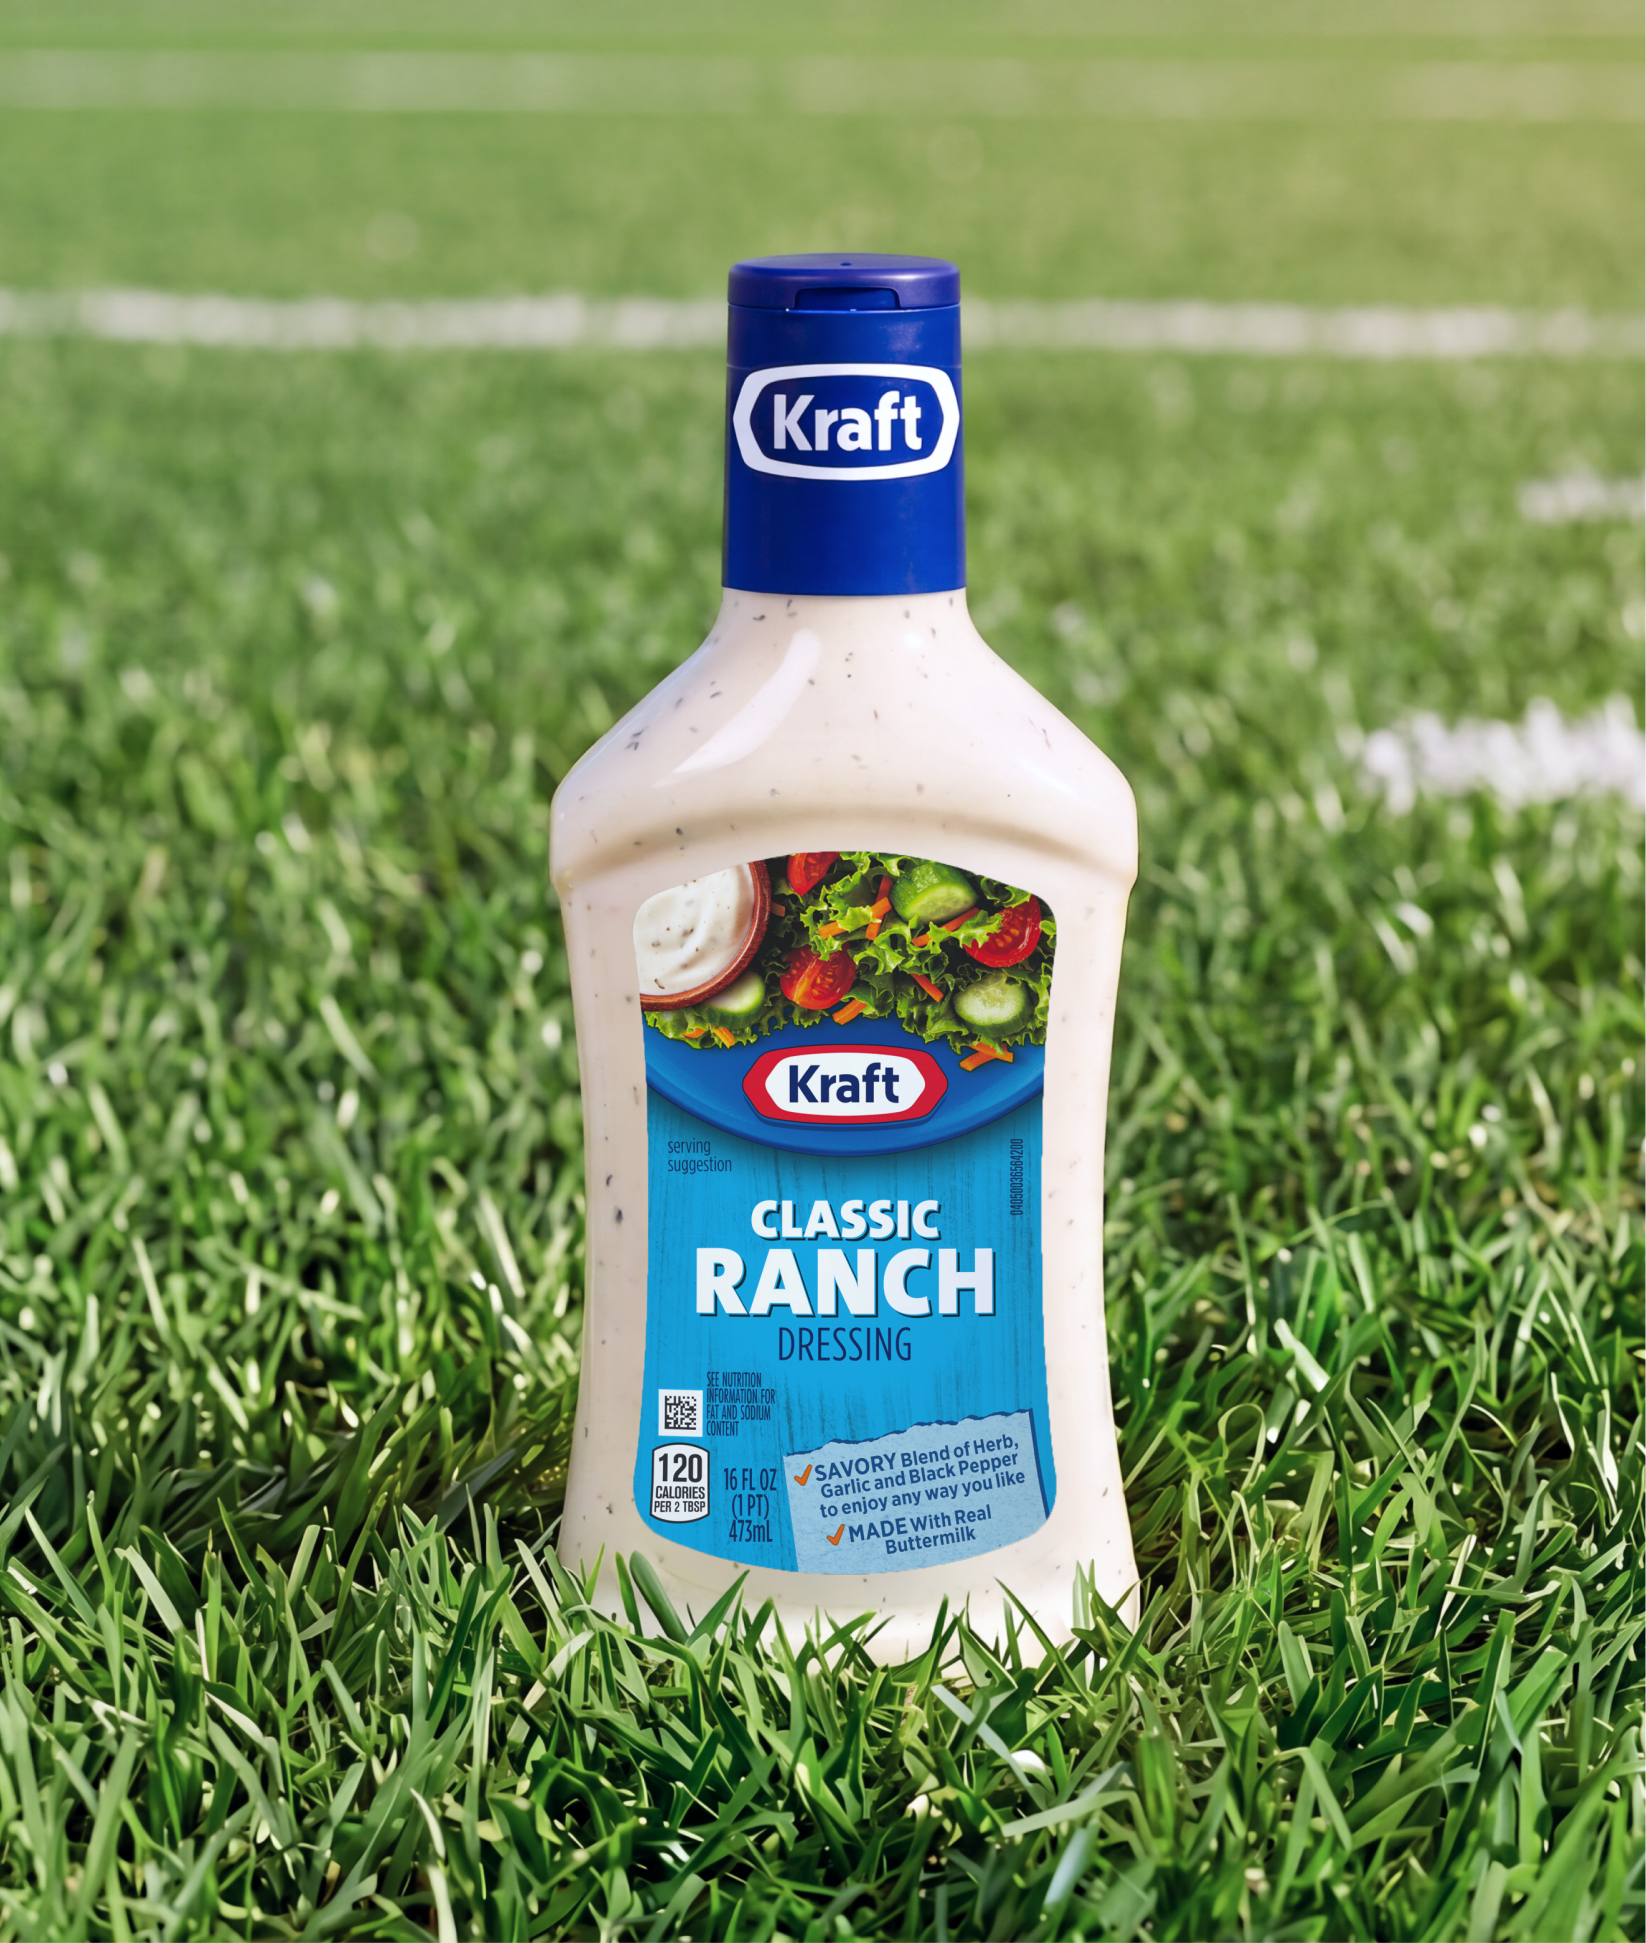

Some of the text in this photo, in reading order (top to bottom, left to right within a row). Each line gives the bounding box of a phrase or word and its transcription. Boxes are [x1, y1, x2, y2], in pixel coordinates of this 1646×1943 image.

[773, 390, 923, 451] Kraft
[788, 1062, 900, 1104] Kraft
[667, 1138, 711, 1156] serving
[667, 1157, 732, 1174] suggestion
[1009, 1138, 1024, 1216] 04050036564200
[751, 1200, 941, 1240] CLASSIC
[696, 1247, 996, 1318] RANCH
[778, 1327, 912, 1362] DRESSING
[706, 1371, 762, 1388] SEE NUTRITION
[706, 1388, 776, 1405] INFORMATION FOR
[706, 1405, 771, 1421] FAT AND SODIUM
[706, 1421, 739, 1437] CONTENT
[658, 1453, 703, 1483] 120
[814, 1434, 1019, 1482] SAVORY Blend of Herb,
[724, 1468, 777, 1491] 16 FL OZ
[820, 1452, 1019, 1499] Garlic and Black Pepper
[654, 1501, 706, 1513] PER 2 TBSP
[655, 1485, 706, 1500] CALORIES
[732, 1493, 770, 1520] (1 PT)
[820, 1469, 1026, 1518] to enjoy any way you like
[729, 1519, 773, 1543] 473mL
[848, 1504, 992, 1543] MADE With Real
[885, 1526, 977, 1555] Buttermilk
